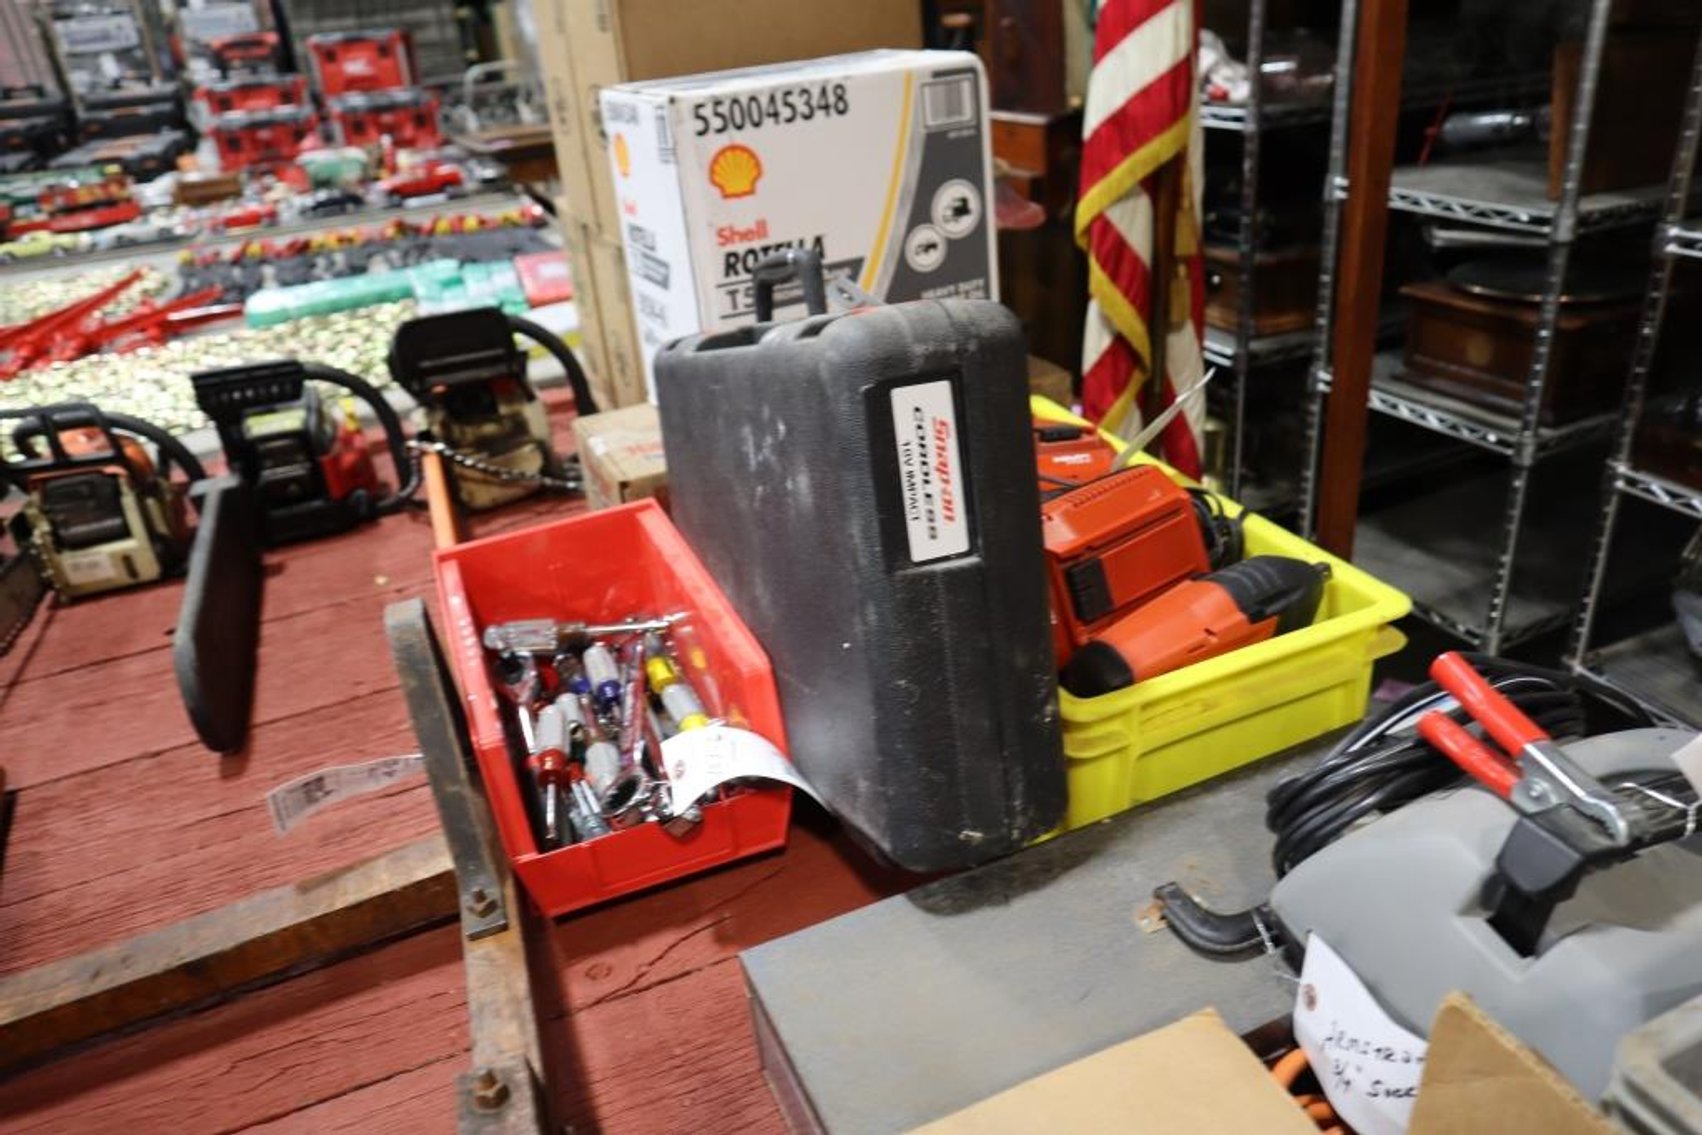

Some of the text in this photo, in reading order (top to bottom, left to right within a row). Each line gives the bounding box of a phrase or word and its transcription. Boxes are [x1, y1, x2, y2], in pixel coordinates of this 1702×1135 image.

[693, 84, 849, 136] 550045348
[716, 219, 769, 246] Shell
[913, 406, 938, 540] CORDLESS
